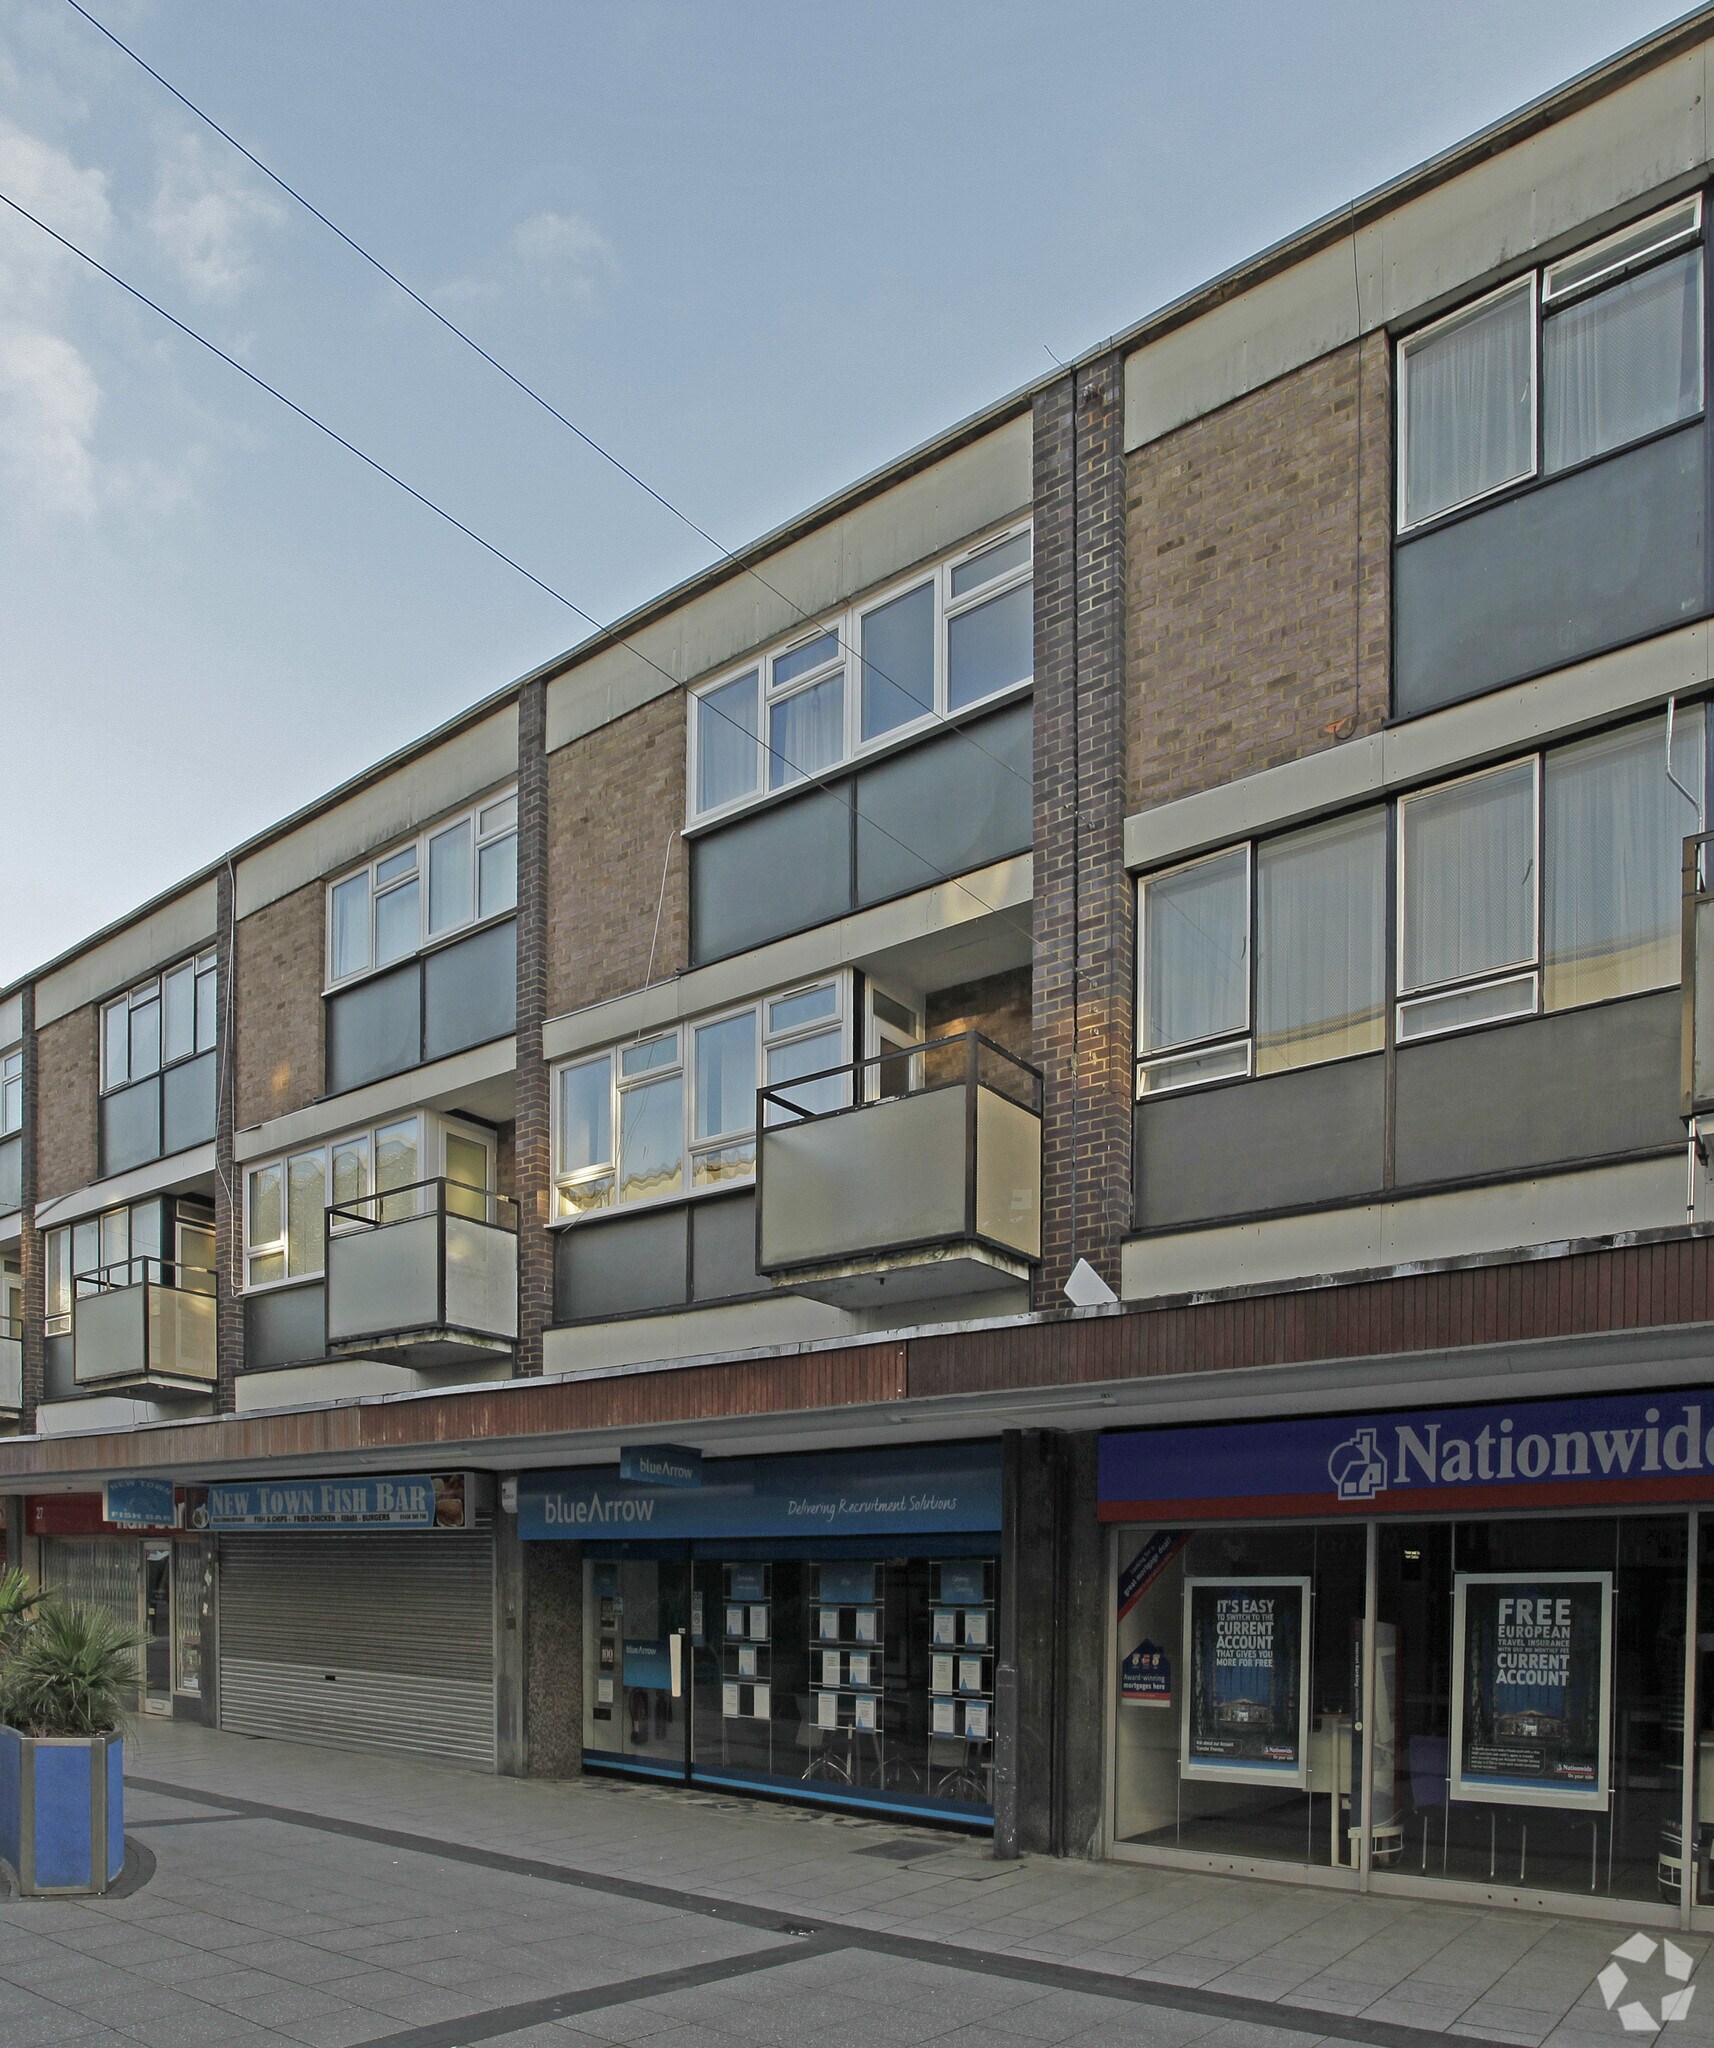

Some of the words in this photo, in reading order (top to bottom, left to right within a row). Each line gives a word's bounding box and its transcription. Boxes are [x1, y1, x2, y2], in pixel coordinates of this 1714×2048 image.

[639, 1457, 693, 1479] blueArrow
[109, 1479, 135, 1490] NEW
[139, 1480, 173, 1496] TOWN
[211, 1489, 249, 1515] NEW
[257, 1487, 315, 1515] TOWN
[320, 1485, 367, 1513] FISH
[376, 1483, 427, 1512] BAR
[36, 1507, 44, 1520] 27
[545, 1491, 655, 1524] blueArrow
[788, 1498, 836, 1523] Delivering
[838, 1497, 907, 1513] Recruitment
[908, 1494, 958, 1512] Solutions
[111, 1511, 142, 1519] FISH
[145, 1513, 171, 1521] BAR
[271, 1515, 288, 1523] CHIPS
[310, 1514, 336, 1522] CHICKEN
[362, 1513, 391, 1522] BURGERS
[1123, 1578, 1138, 1597] great
[1136, 1553, 1160, 1581] mortgage
[1217, 1599, 1239, 1614] IT'S
[1242, 1599, 1276, 1614] EASY
[1498, 1598, 1572, 1626] FREE
[1217, 1613, 1226, 1621] TO
[1226, 1613, 1251, 1621] SWITCH
[1251, 1613, 1261, 1621] TO
[1261, 1613, 1274, 1621] THE
[1216, 1621, 1275, 1636] CURRENT
[1498, 1625, 1571, 1639] EUROPEAN
[1215, 1635, 1274, 1650] ACCOUNT
[1498, 1638, 1525, 1647] TRAVEL
[1527, 1639, 1571, 1647] INSURANCE
[1216, 1650, 1234, 1658] THAT
[1235, 1650, 1257, 1658] GIVES
[1258, 1650, 1274, 1659] YOU
[1497, 1653, 1571, 1670] CURRENT
[1216, 1658, 1237, 1667] MORE
[1238, 1658, 1253, 1667] FOR
[1255, 1659, 1274, 1668] FREE
[1123, 1674, 1166, 1683] Award-winning
[1495, 1669, 1570, 1687] ACCOUNT
[1123, 1682, 1152, 1691] mortgages
[1562, 1763, 1593, 1773] Nationwide
